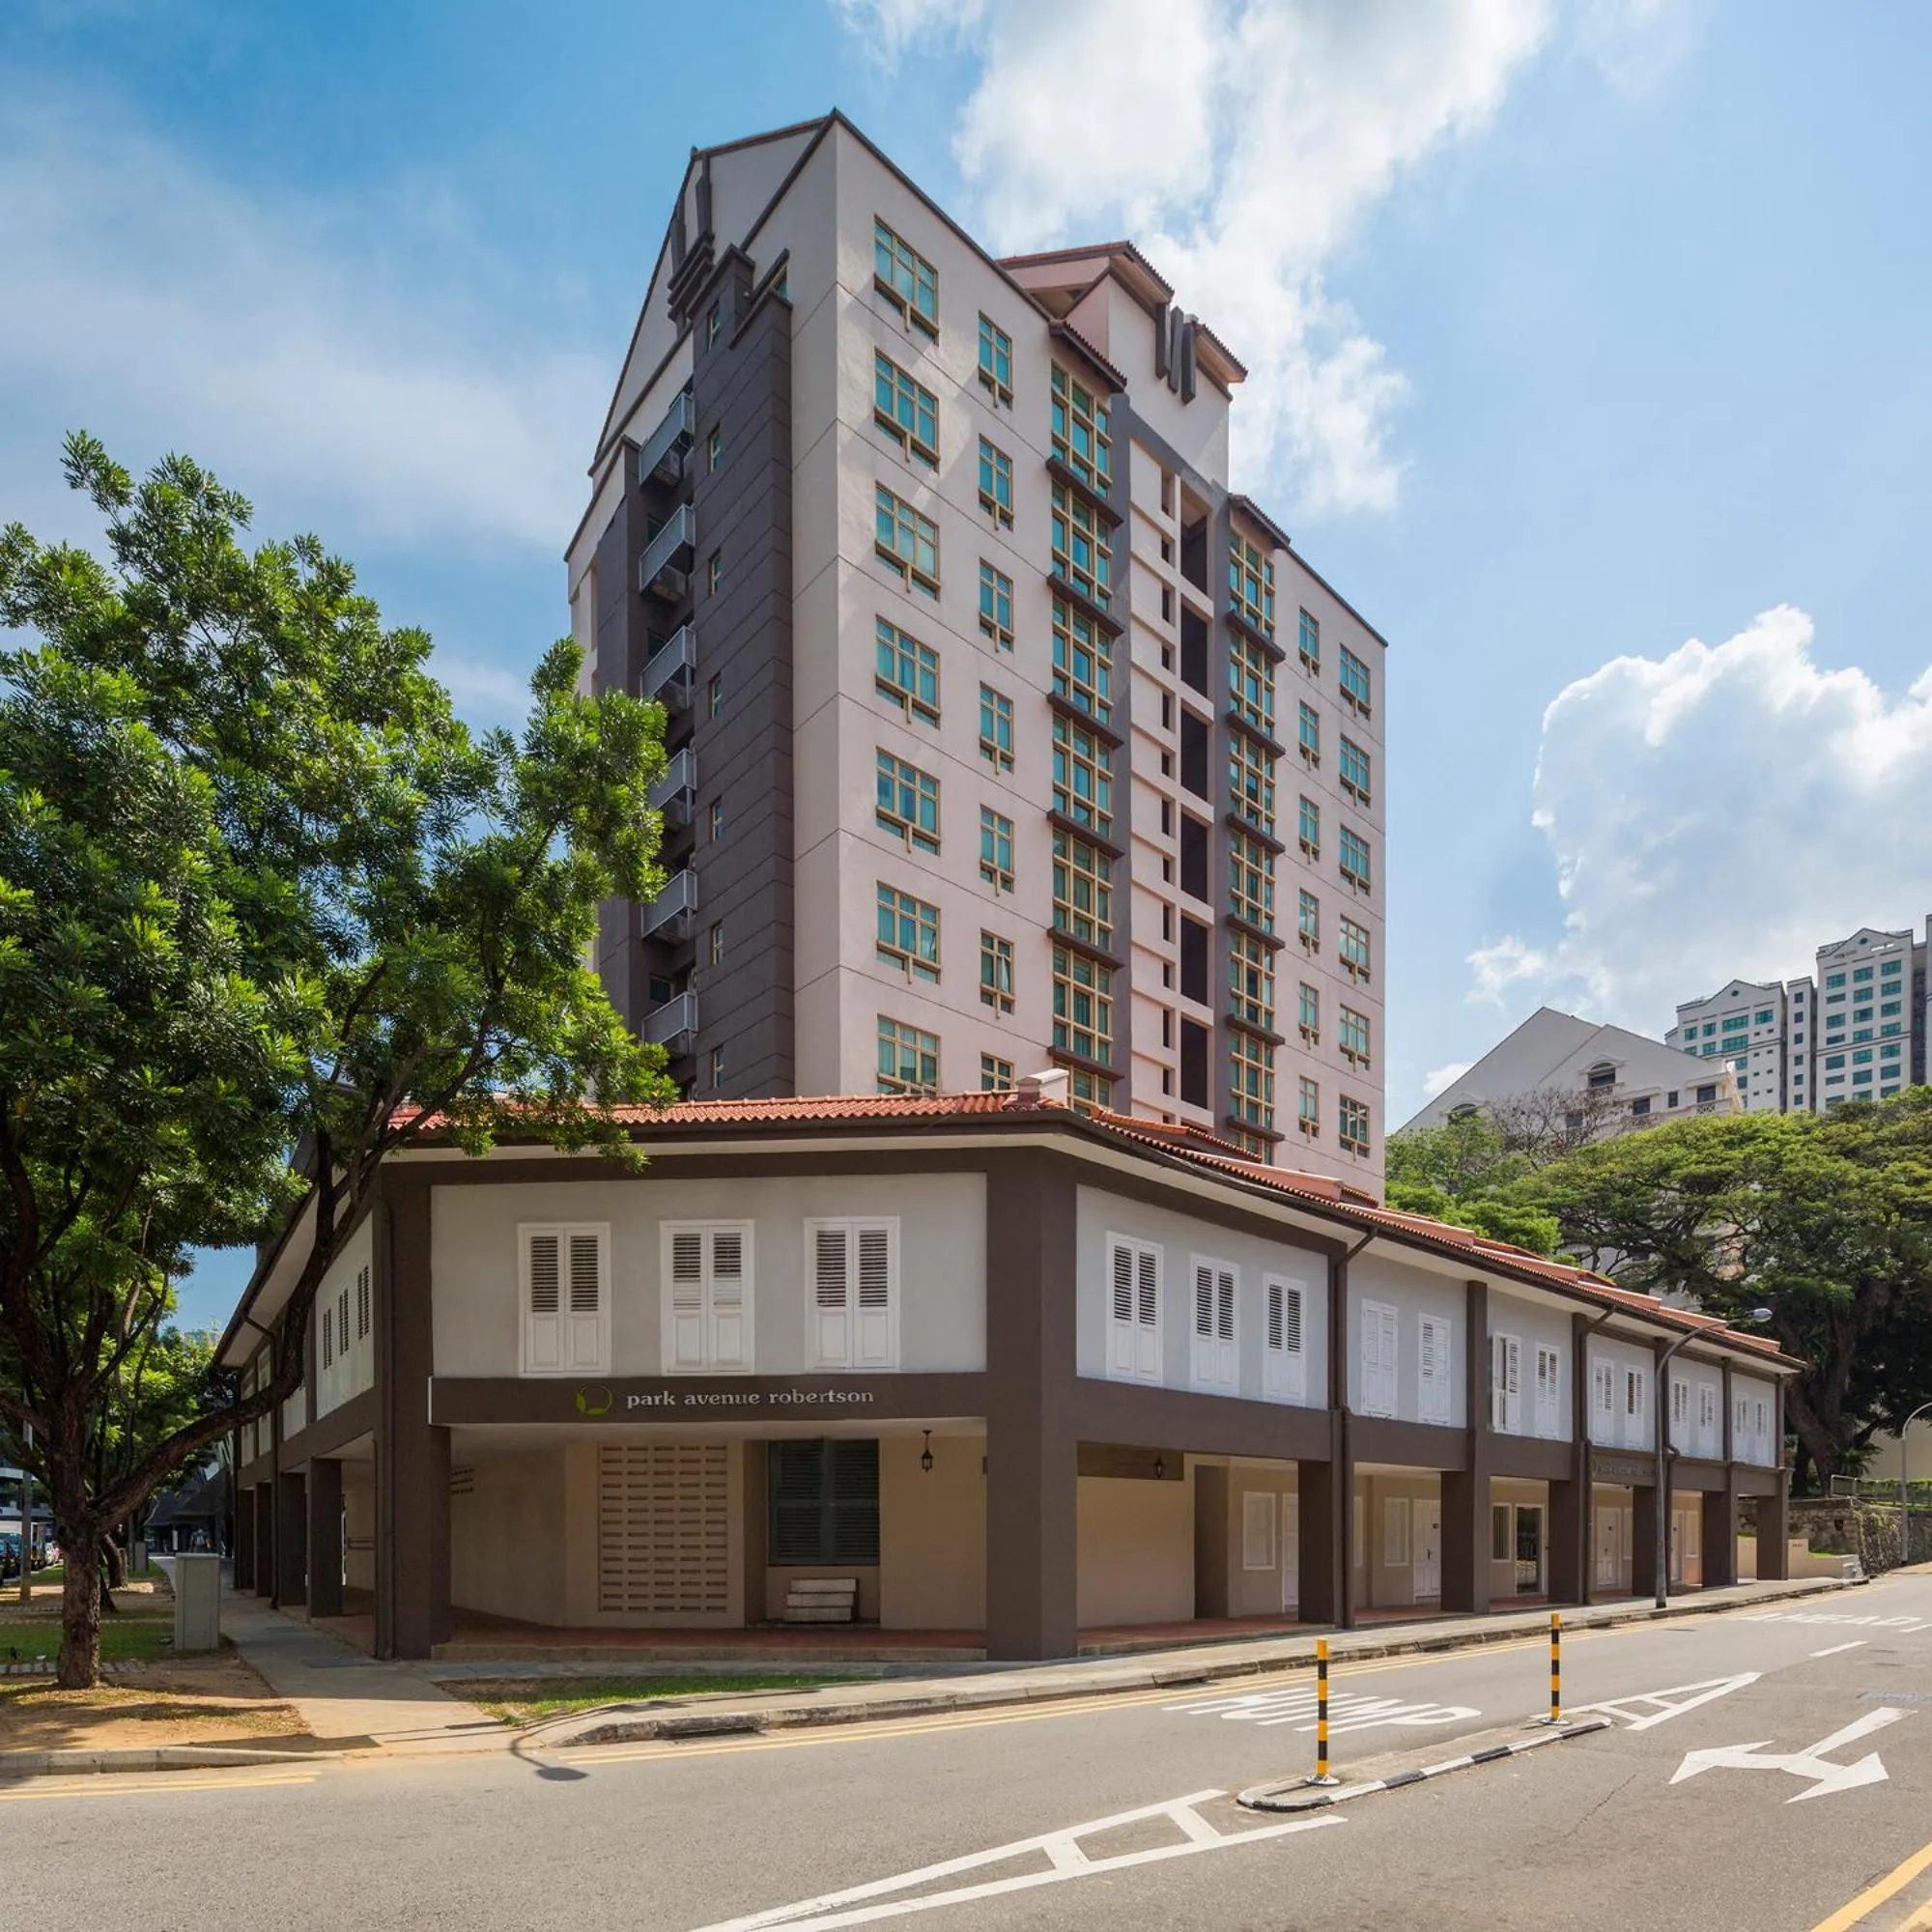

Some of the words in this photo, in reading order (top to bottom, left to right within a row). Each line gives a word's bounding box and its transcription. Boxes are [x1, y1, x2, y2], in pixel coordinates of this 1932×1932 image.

[627, 1391, 675, 1409] park
[684, 1392, 760, 1406] avenue
[769, 1388, 874, 1404] robertson
[1162, 1688, 1482, 1735] HUMP
